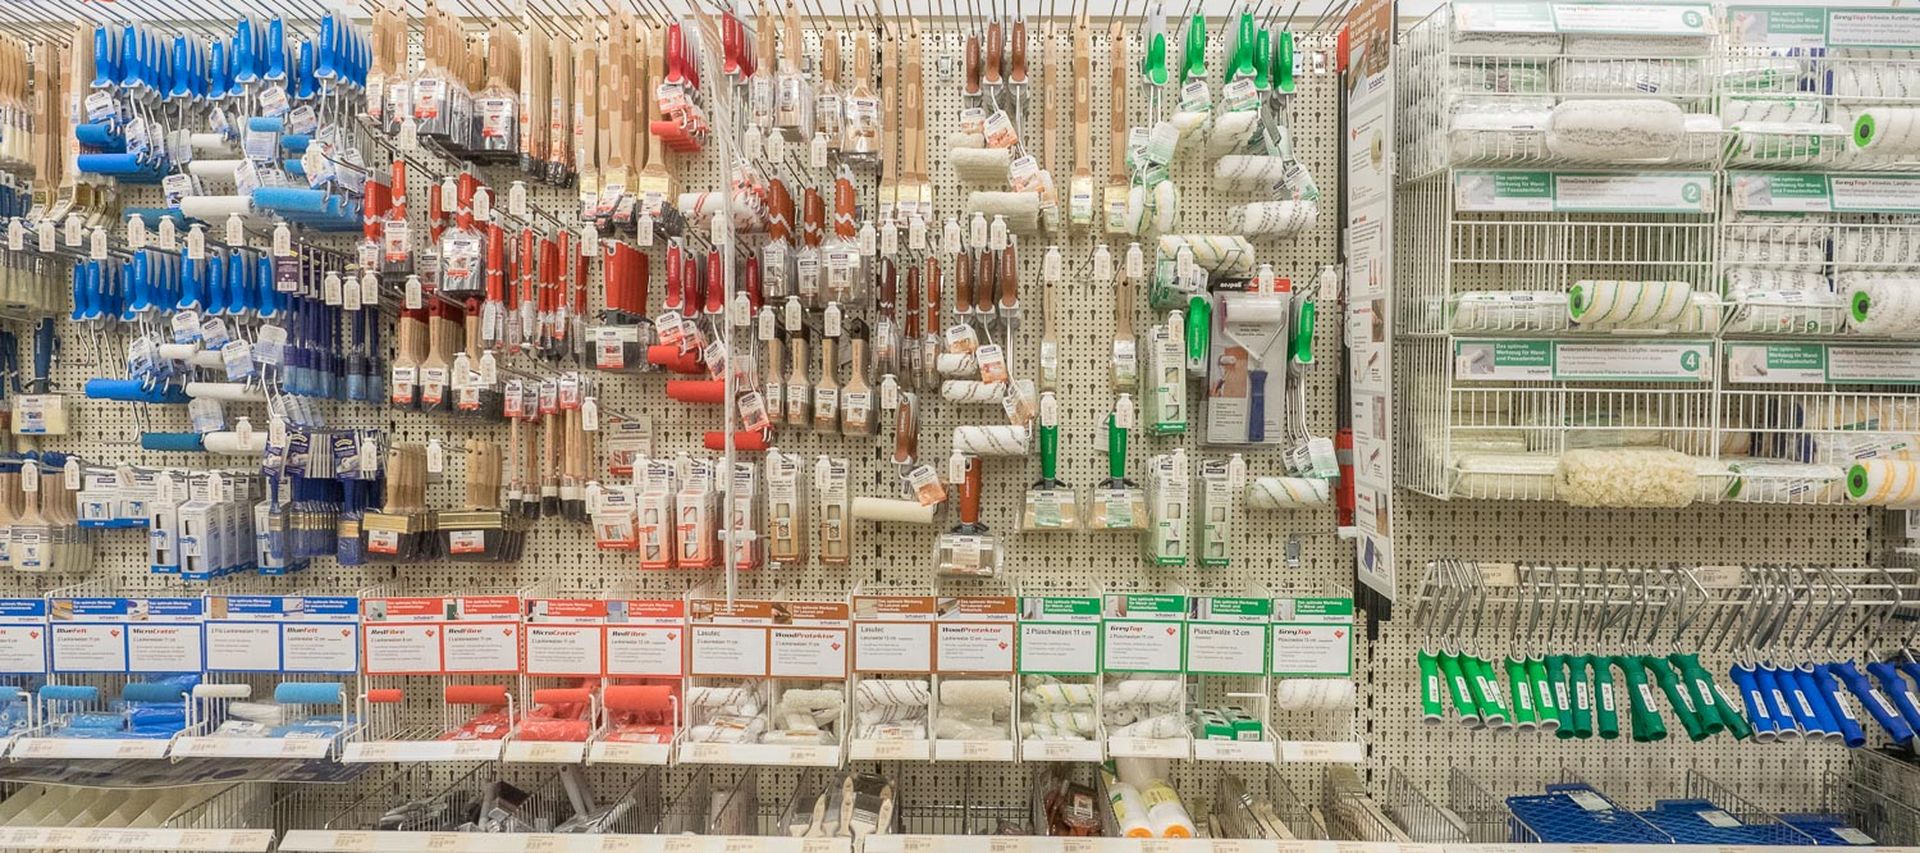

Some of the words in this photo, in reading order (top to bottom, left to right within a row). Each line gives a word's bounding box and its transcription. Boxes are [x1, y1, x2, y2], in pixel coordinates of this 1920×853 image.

[1688, 13, 1697, 25] 5
[1687, 186, 1697, 198] 2
[1686, 353, 1696, 367] 4
